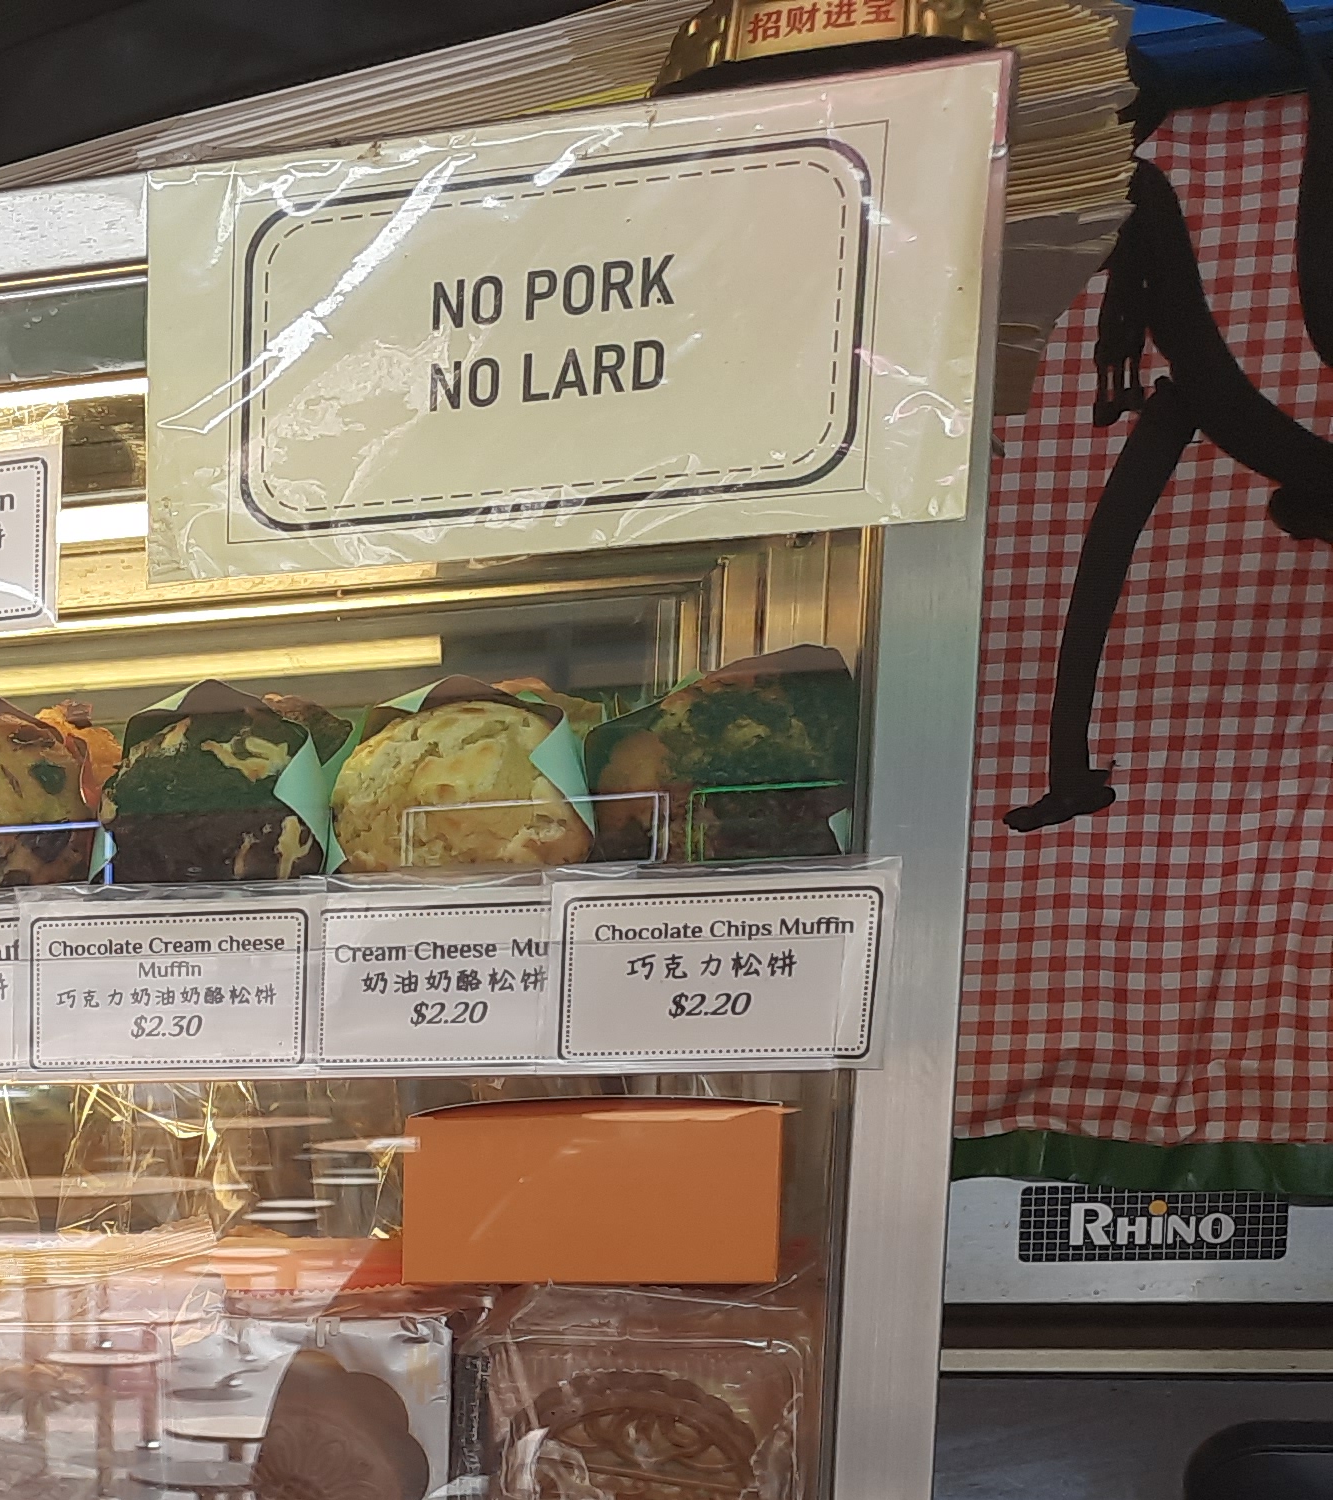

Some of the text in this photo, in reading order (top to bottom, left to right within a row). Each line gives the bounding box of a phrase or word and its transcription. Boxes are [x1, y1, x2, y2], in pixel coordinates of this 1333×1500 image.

[747, 0, 896, 43] 招财进宝
[433, 254, 675, 330] NO PORK
[429, 340, 665, 412] NO LARD
[595, 917, 854, 941] Chocolate Chips Muffin
[49, 936, 285, 957] Chocolate Cream cheese
[335, 942, 497, 963] Cream Cheese
[138, 961, 202, 978] Muffin
[626, 949, 797, 980] 巧克力松饼
[410, 1001, 488, 1026] $2.20
[668, 992, 752, 1019] $2.20
[131, 1015, 203, 1039] $2.30
